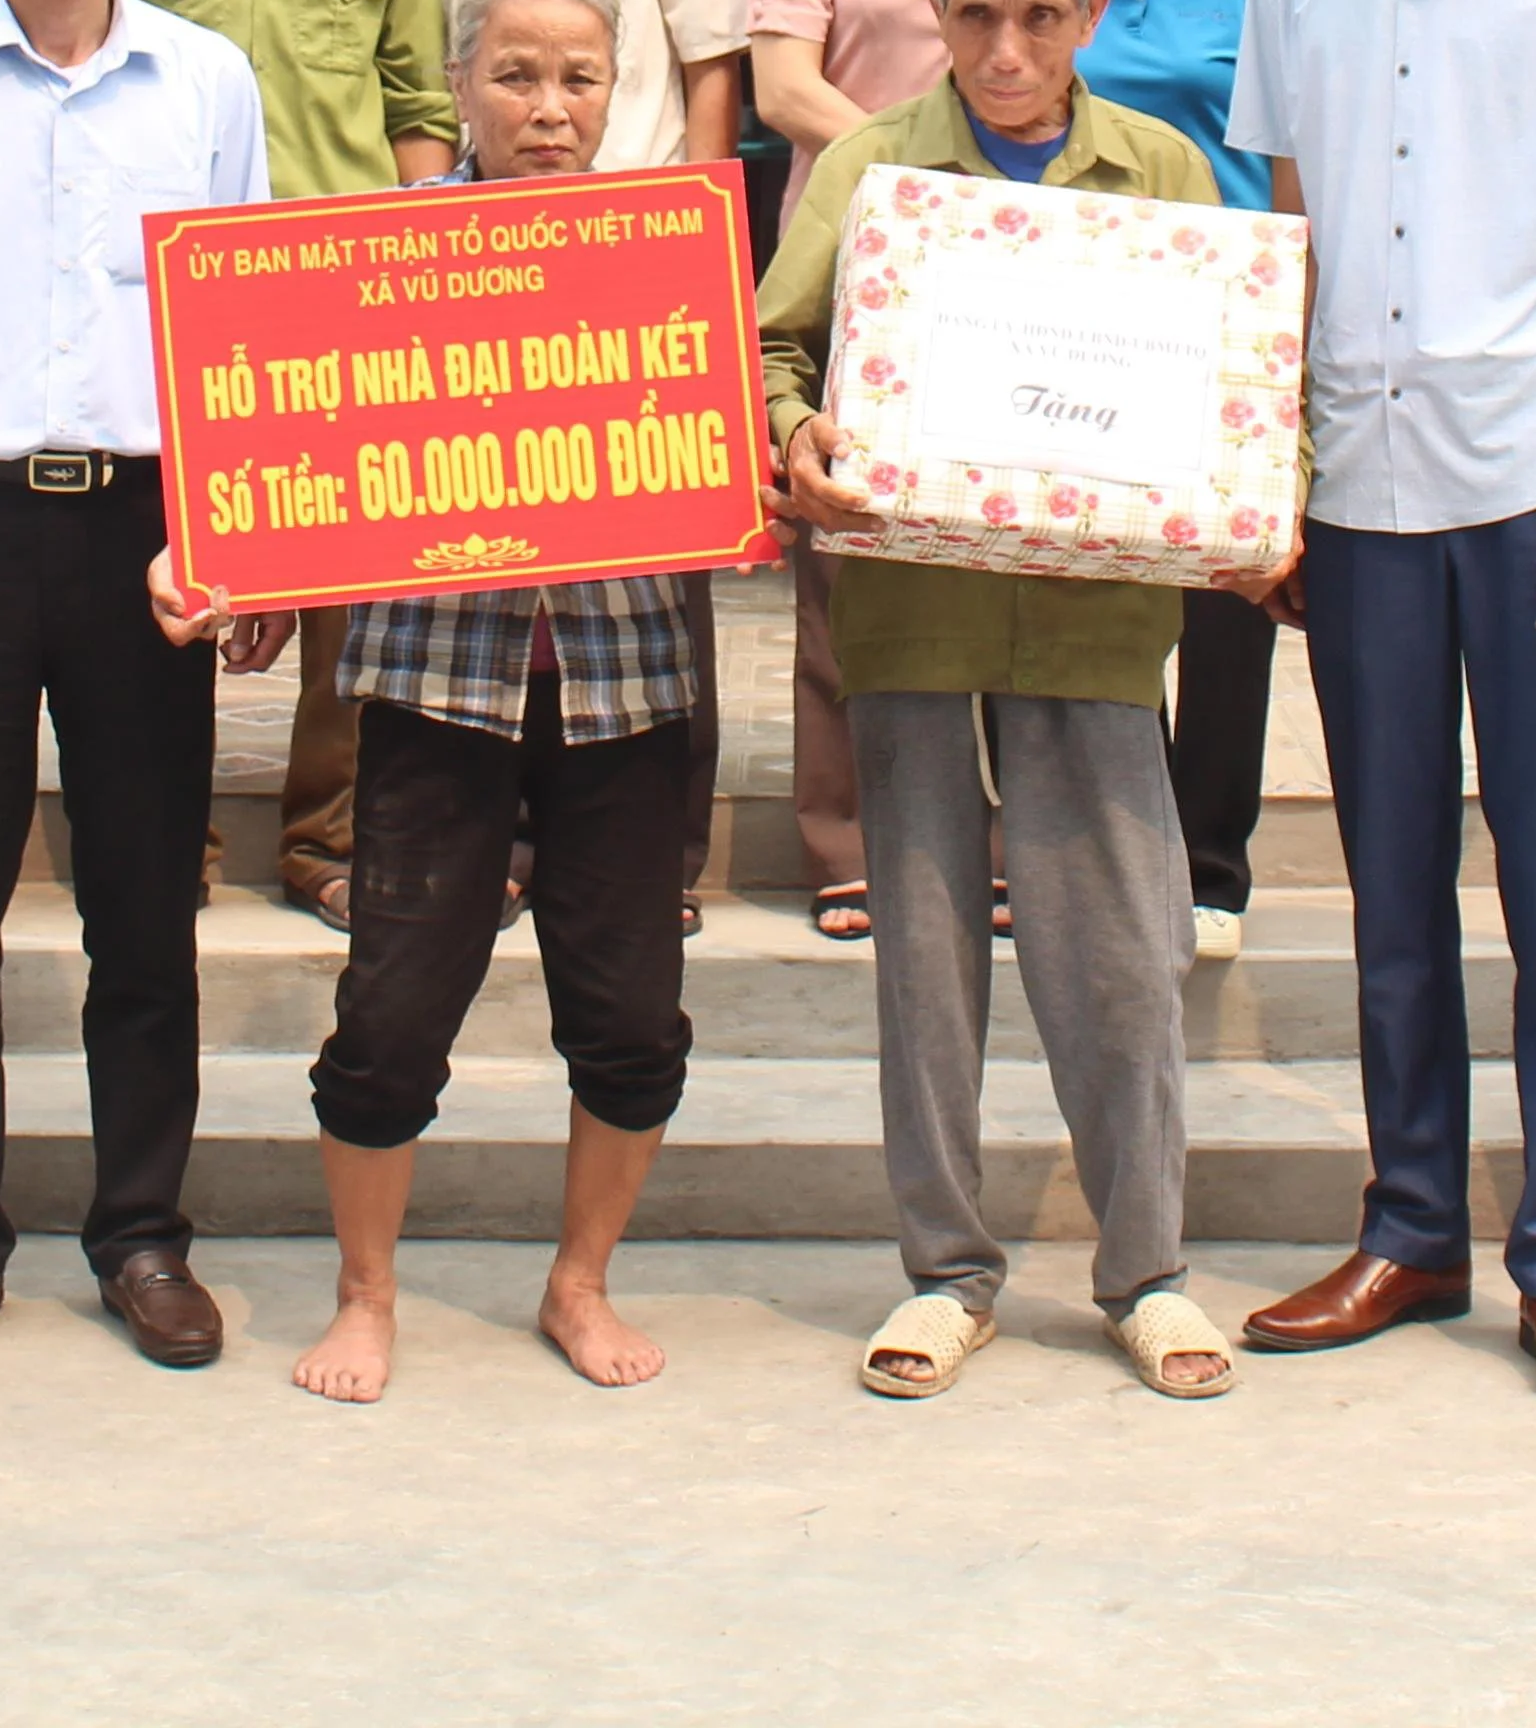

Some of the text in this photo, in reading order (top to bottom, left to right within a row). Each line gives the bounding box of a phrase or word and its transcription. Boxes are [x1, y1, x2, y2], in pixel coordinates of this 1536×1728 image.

[189, 207, 704, 281] ỦY BAN MẶT TRẬN TỔ QUỐC VIỆT NAM
[357, 263, 545, 307] XÃ VŨ DƯƠNG
[201, 303, 710, 423] HỖ TRỢ NHÀ ĐẠI ĐOÀN KẾT
[1010, 383, 1120, 433] Tặng
[207, 388, 731, 536] Số Tiền: 60.000.000 ĐỒNG
